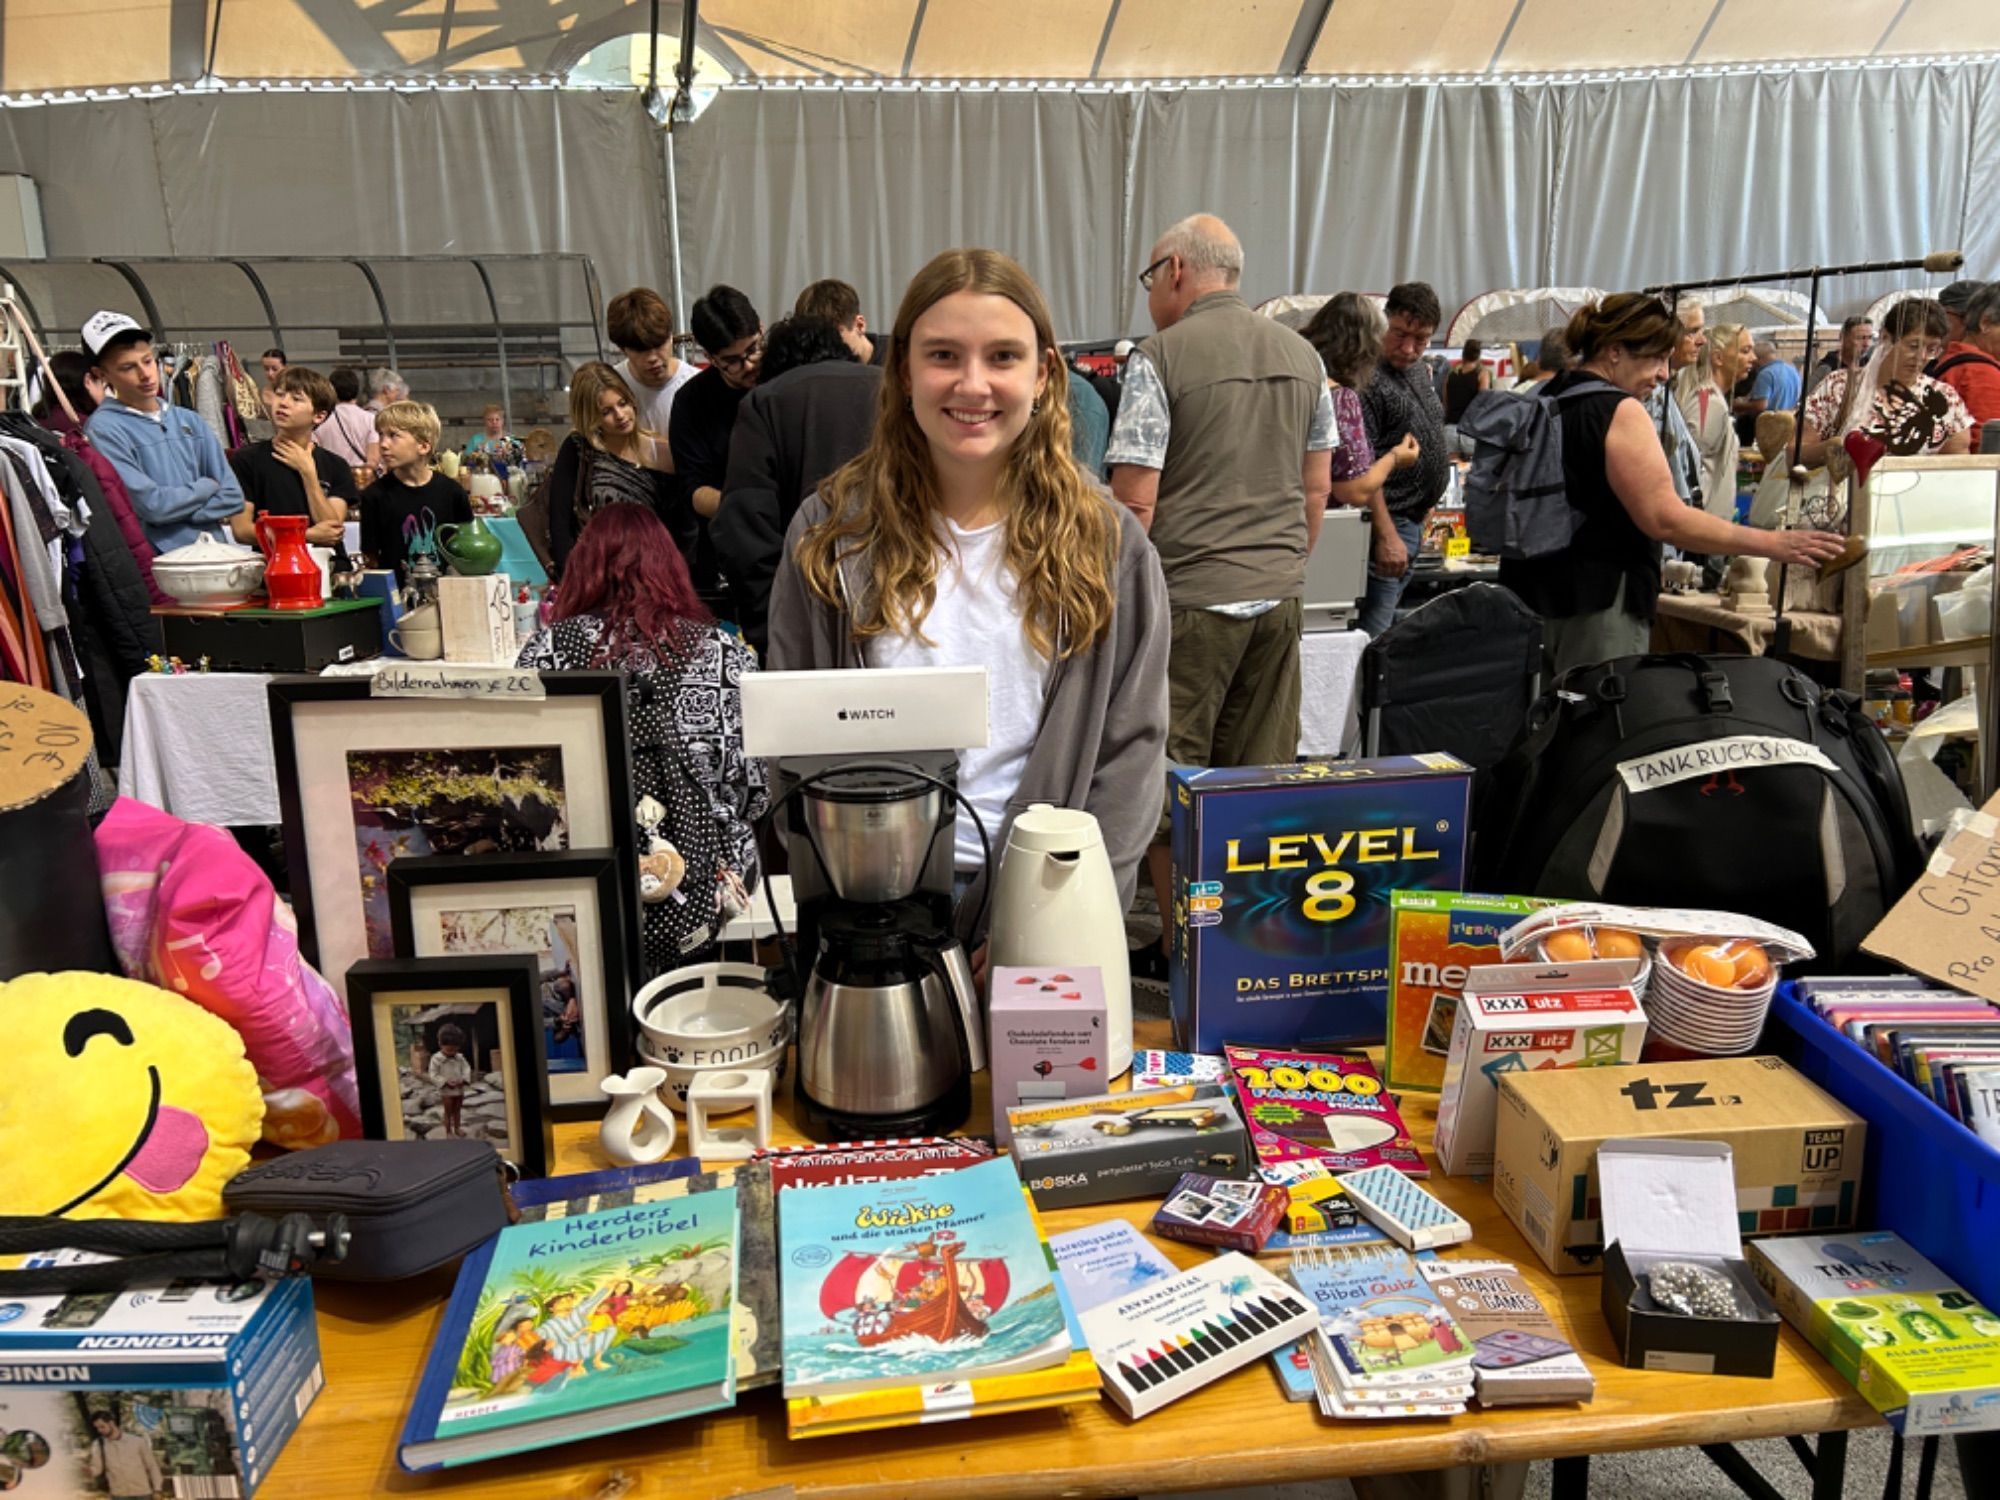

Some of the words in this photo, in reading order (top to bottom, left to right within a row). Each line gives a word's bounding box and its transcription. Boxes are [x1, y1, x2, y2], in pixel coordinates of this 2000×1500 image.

[377, 671, 481, 692] Bilderrahmen
[849, 708, 895, 721] WATCH
[1225, 827, 1440, 874] LEVEL
[1302, 870, 1356, 921] 8
[1452, 923, 1500, 939] TIERKI
[1237, 977, 1280, 991] DAS
[1289, 968, 1388, 988] BRETTSPI
[1401, 960, 1469, 988] me
[1948, 955, 1994, 981] Pro
[1236, 1067, 1384, 1096] 2000
[1809, 1133, 1841, 1144] TEAM
[1806, 1149, 1839, 1170] UP
[1030, 1172, 1089, 1190] BOSKA
[565, 1207, 672, 1236] Herders
[831, 1234, 858, 1242] und
[861, 1230, 881, 1239] die
[884, 1223, 933, 1237] starken
[936, 1212, 986, 1231] Männer
[856, 1203, 955, 1229] Wickie
[528, 1214, 699, 1258] Kinderbibel
[1315, 1286, 1367, 1302] Bibel
[1370, 1277, 1419, 1297] Quiz
[1455, 1277, 1516, 1295] TRAVEL
[1481, 1295, 1541, 1311] GAMES
[77, 1335, 229, 1348] MAGINON
[0, 1366, 90, 1381] GINON
